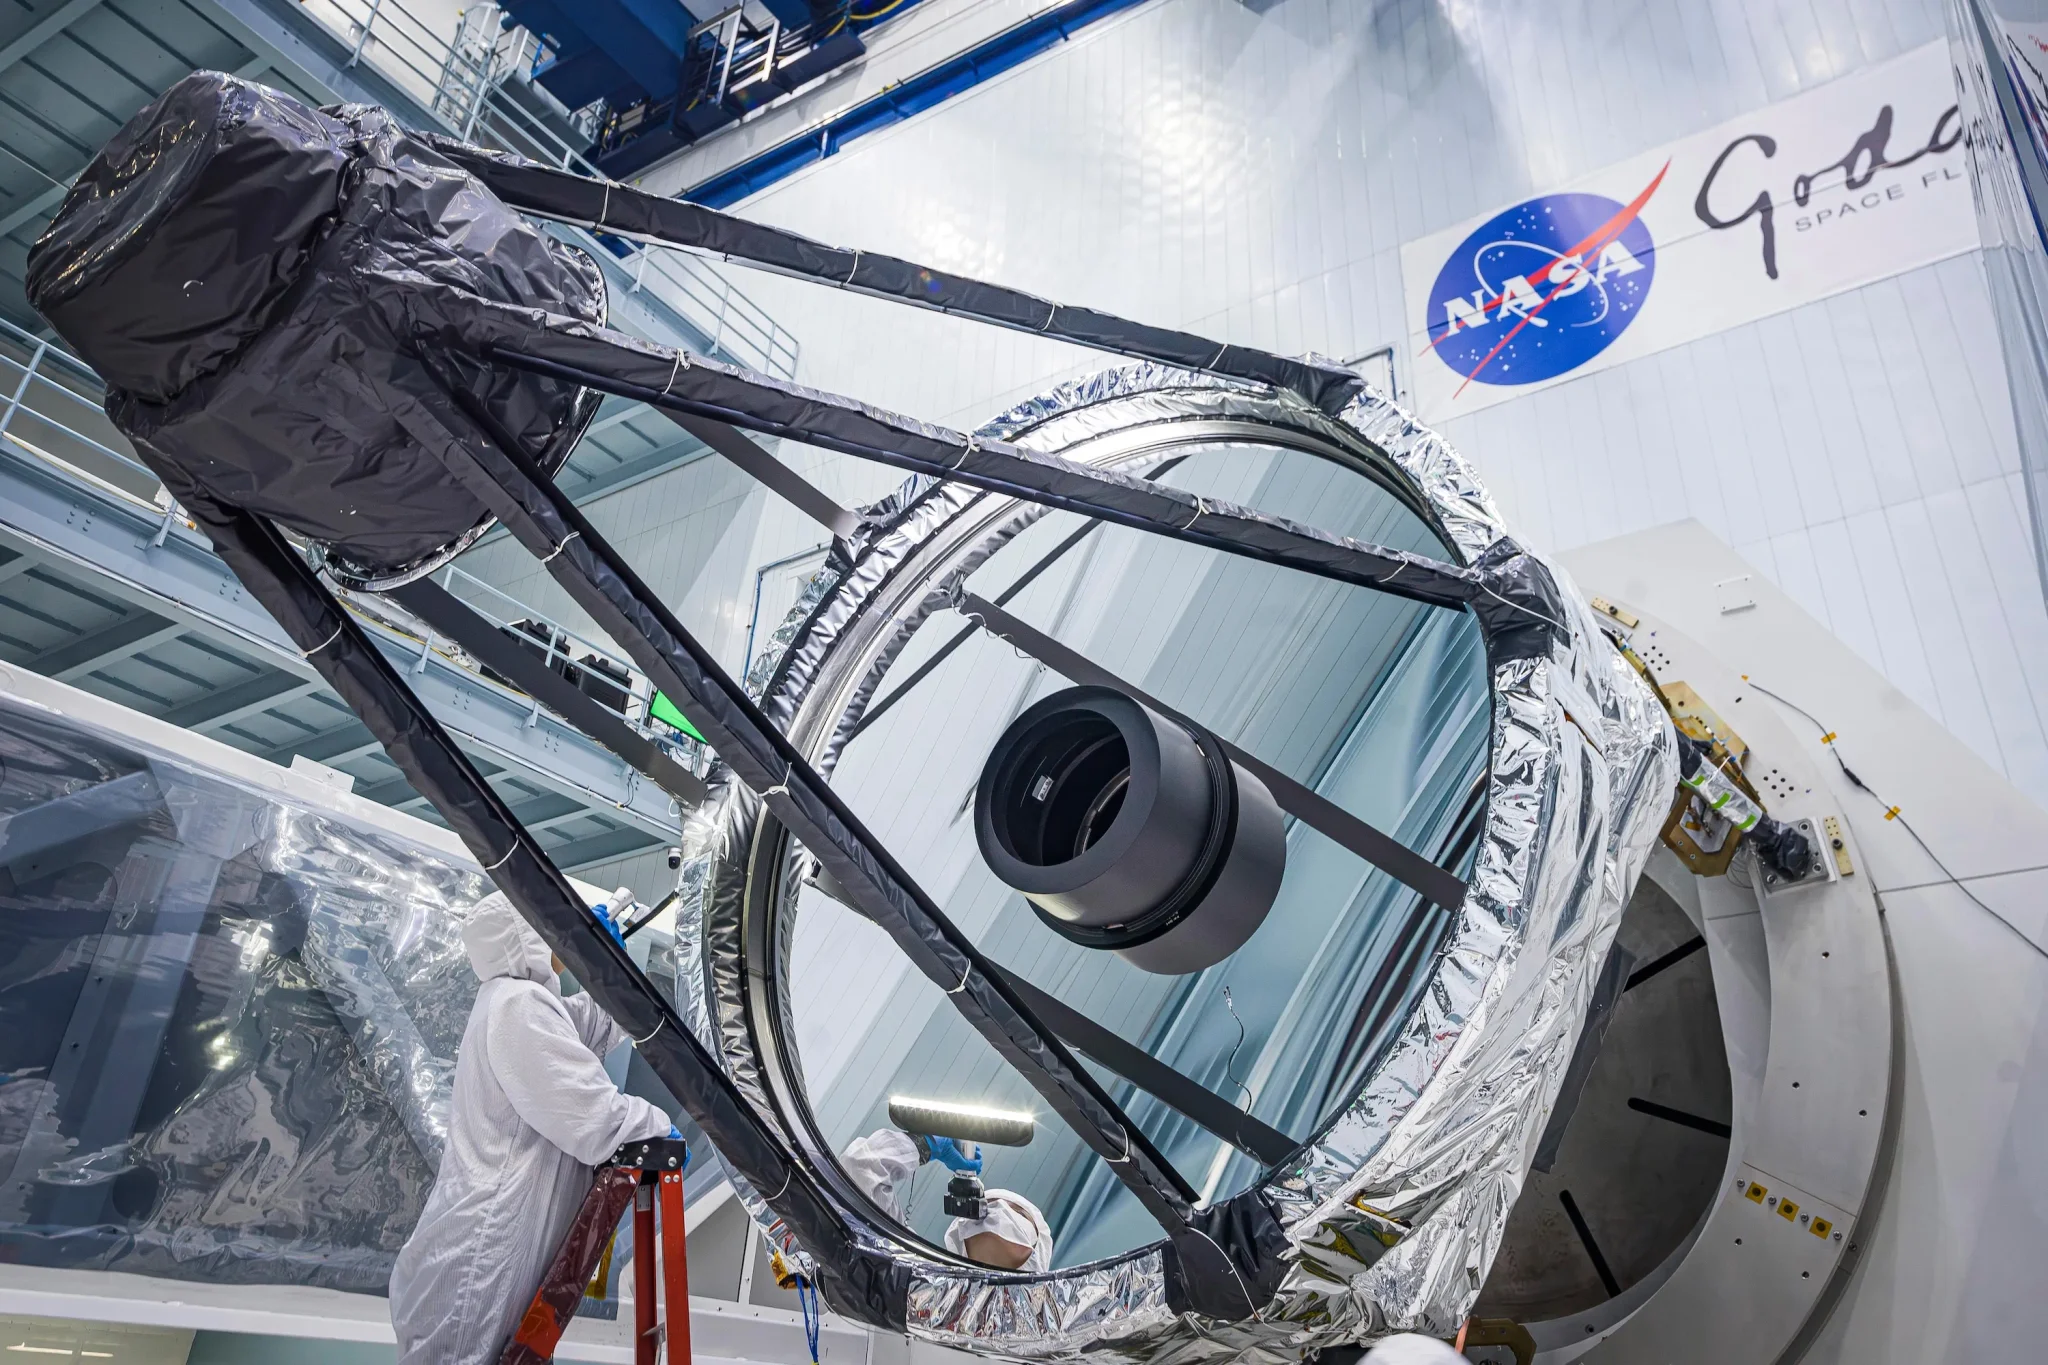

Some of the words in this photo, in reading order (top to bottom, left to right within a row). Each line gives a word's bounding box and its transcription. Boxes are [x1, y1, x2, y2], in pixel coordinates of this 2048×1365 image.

[1795, 183, 1906, 233] SPACE
[1921, 166, 1966, 189] FL
[1442, 240, 1646, 338] NASA
